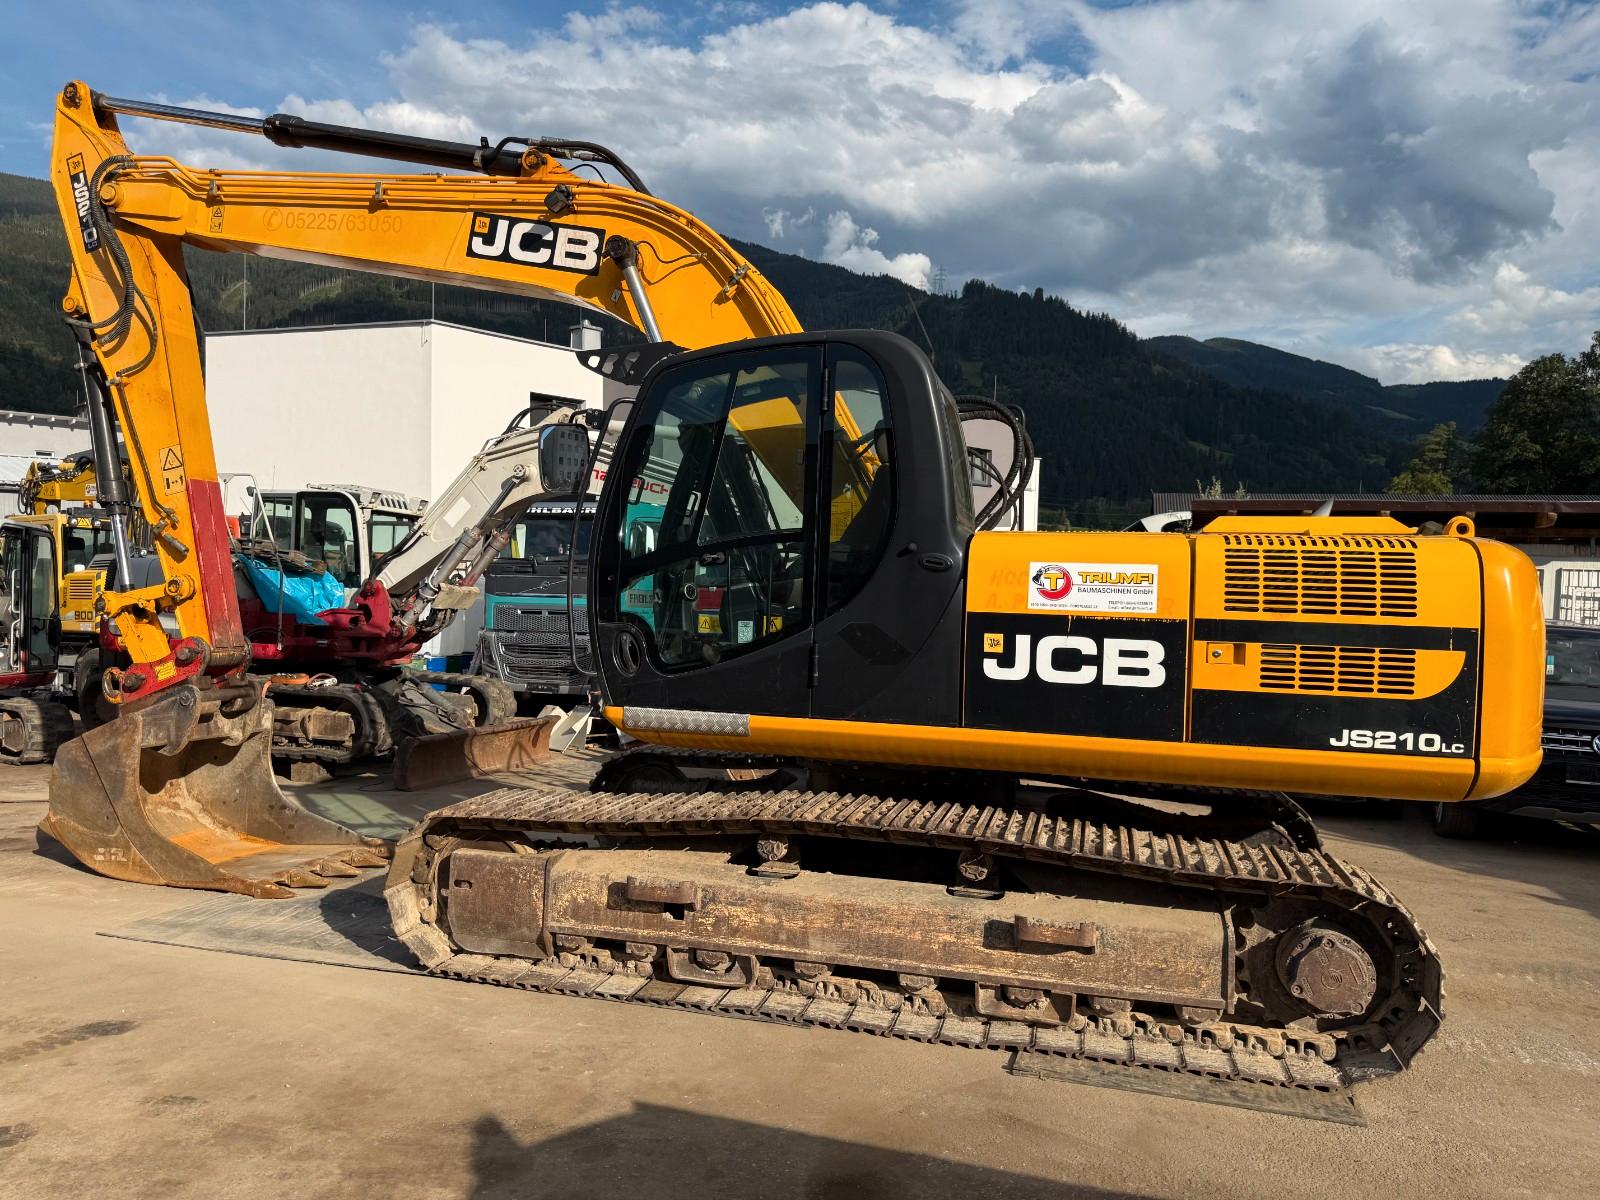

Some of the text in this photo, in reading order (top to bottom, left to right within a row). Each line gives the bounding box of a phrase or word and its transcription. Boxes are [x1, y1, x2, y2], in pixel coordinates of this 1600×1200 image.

[285, 211, 403, 233] 05225/63050
[471, 219, 600, 271] JCB
[1078, 571, 1154, 585] TRIUMFI
[1077, 586, 1132, 595] BAUMASCHINEN
[983, 634, 1167, 688] JCB
